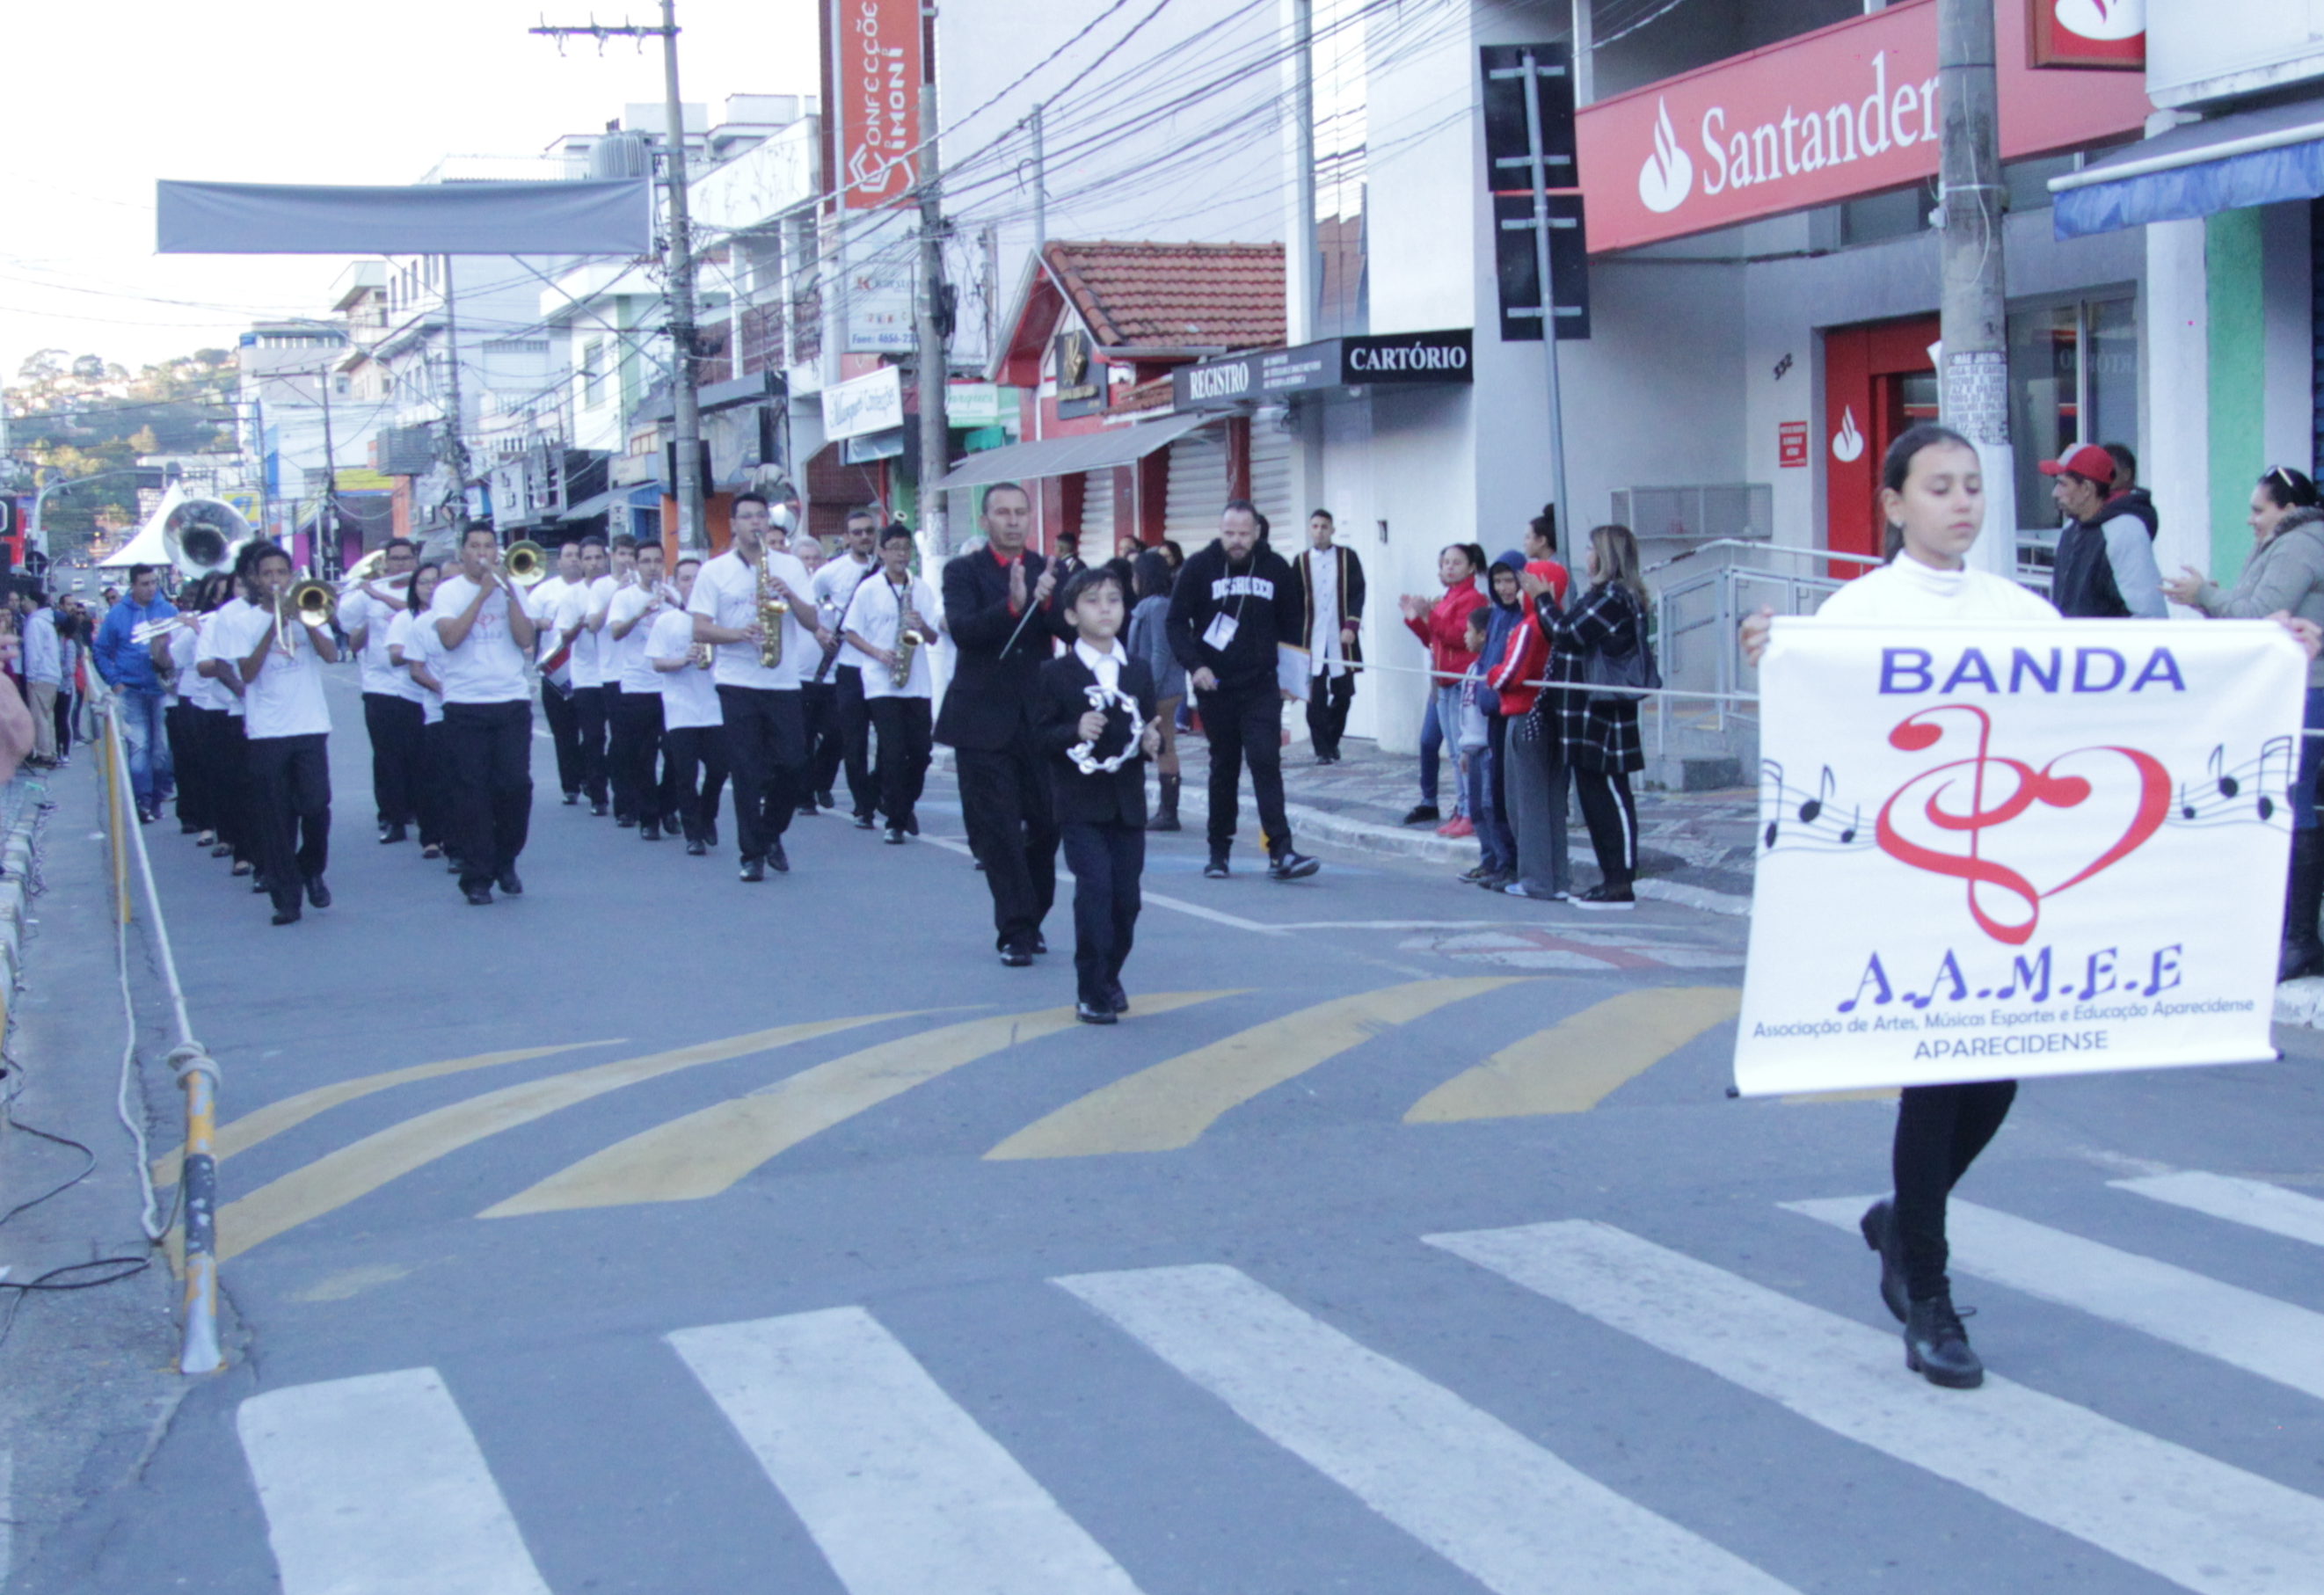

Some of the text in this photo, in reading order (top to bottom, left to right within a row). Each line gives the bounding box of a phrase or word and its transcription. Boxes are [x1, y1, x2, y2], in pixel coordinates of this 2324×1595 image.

[1701, 49, 1939, 195] Santander
[1350, 340, 1468, 370] CARTÓRIO
[1190, 361, 1249, 400] REGISTRO
[1878, 647, 2187, 695] BANDA
[1753, 997, 2255, 1038] Associação de Artes, Músicas Esportes e Educação Aparecidense
[1914, 1030, 2109, 1060] APARECIDENSE
